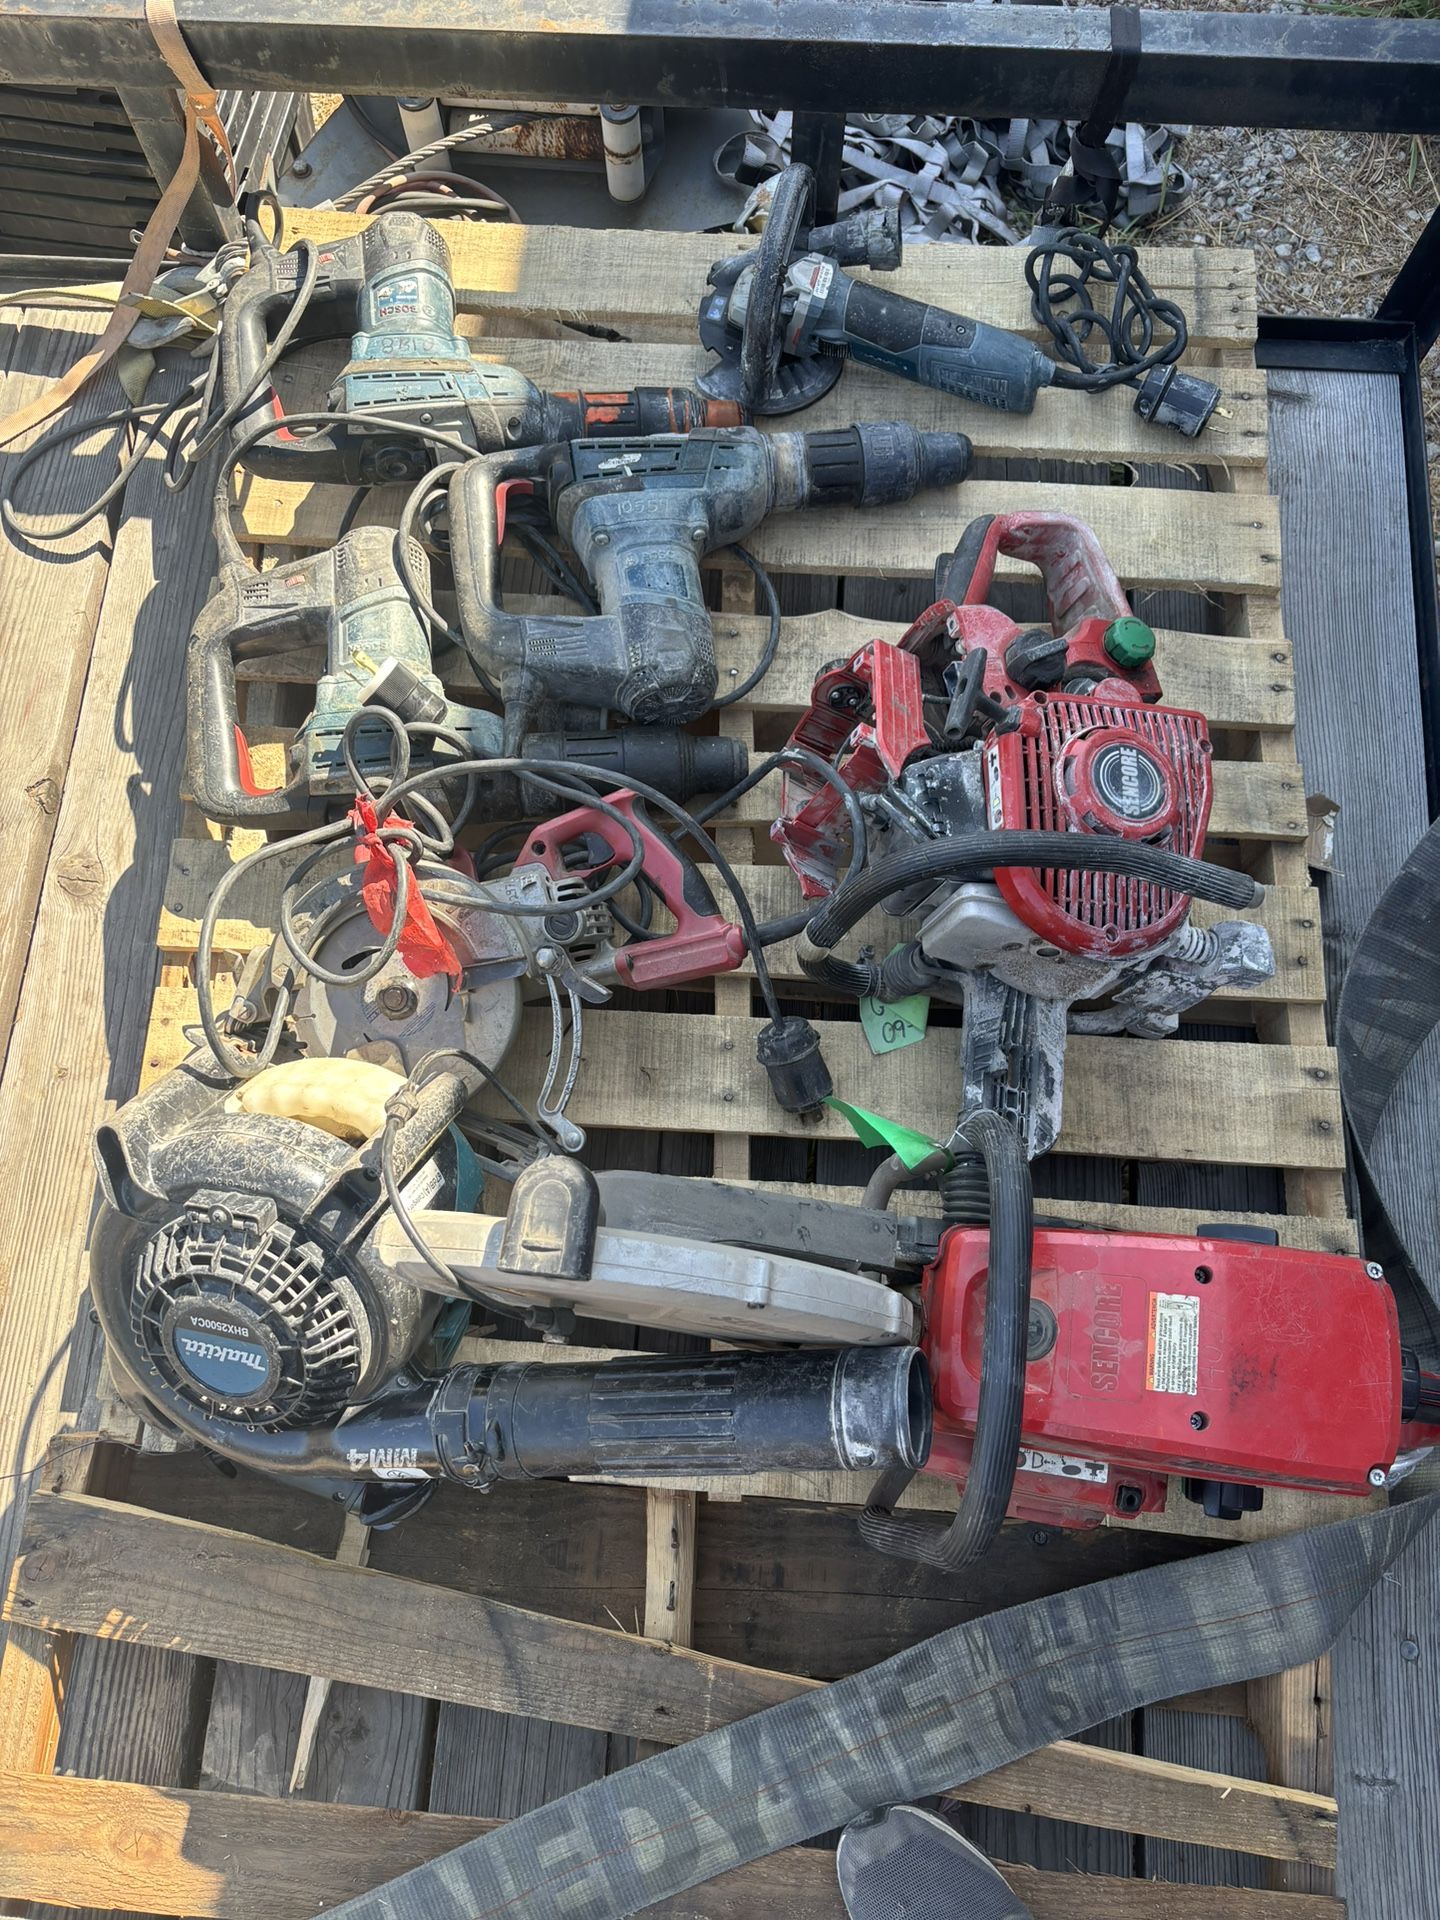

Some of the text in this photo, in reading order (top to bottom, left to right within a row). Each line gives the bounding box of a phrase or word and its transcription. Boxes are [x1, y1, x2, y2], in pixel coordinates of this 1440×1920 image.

[379, 304, 418, 318] BOSCH
[1119, 746, 1141, 816] SENCORE
[190, 1316, 249, 1338] BHX2500CA
[1090, 1283, 1121, 1391] SENCORE
[346, 1448, 419, 1473] MM4
